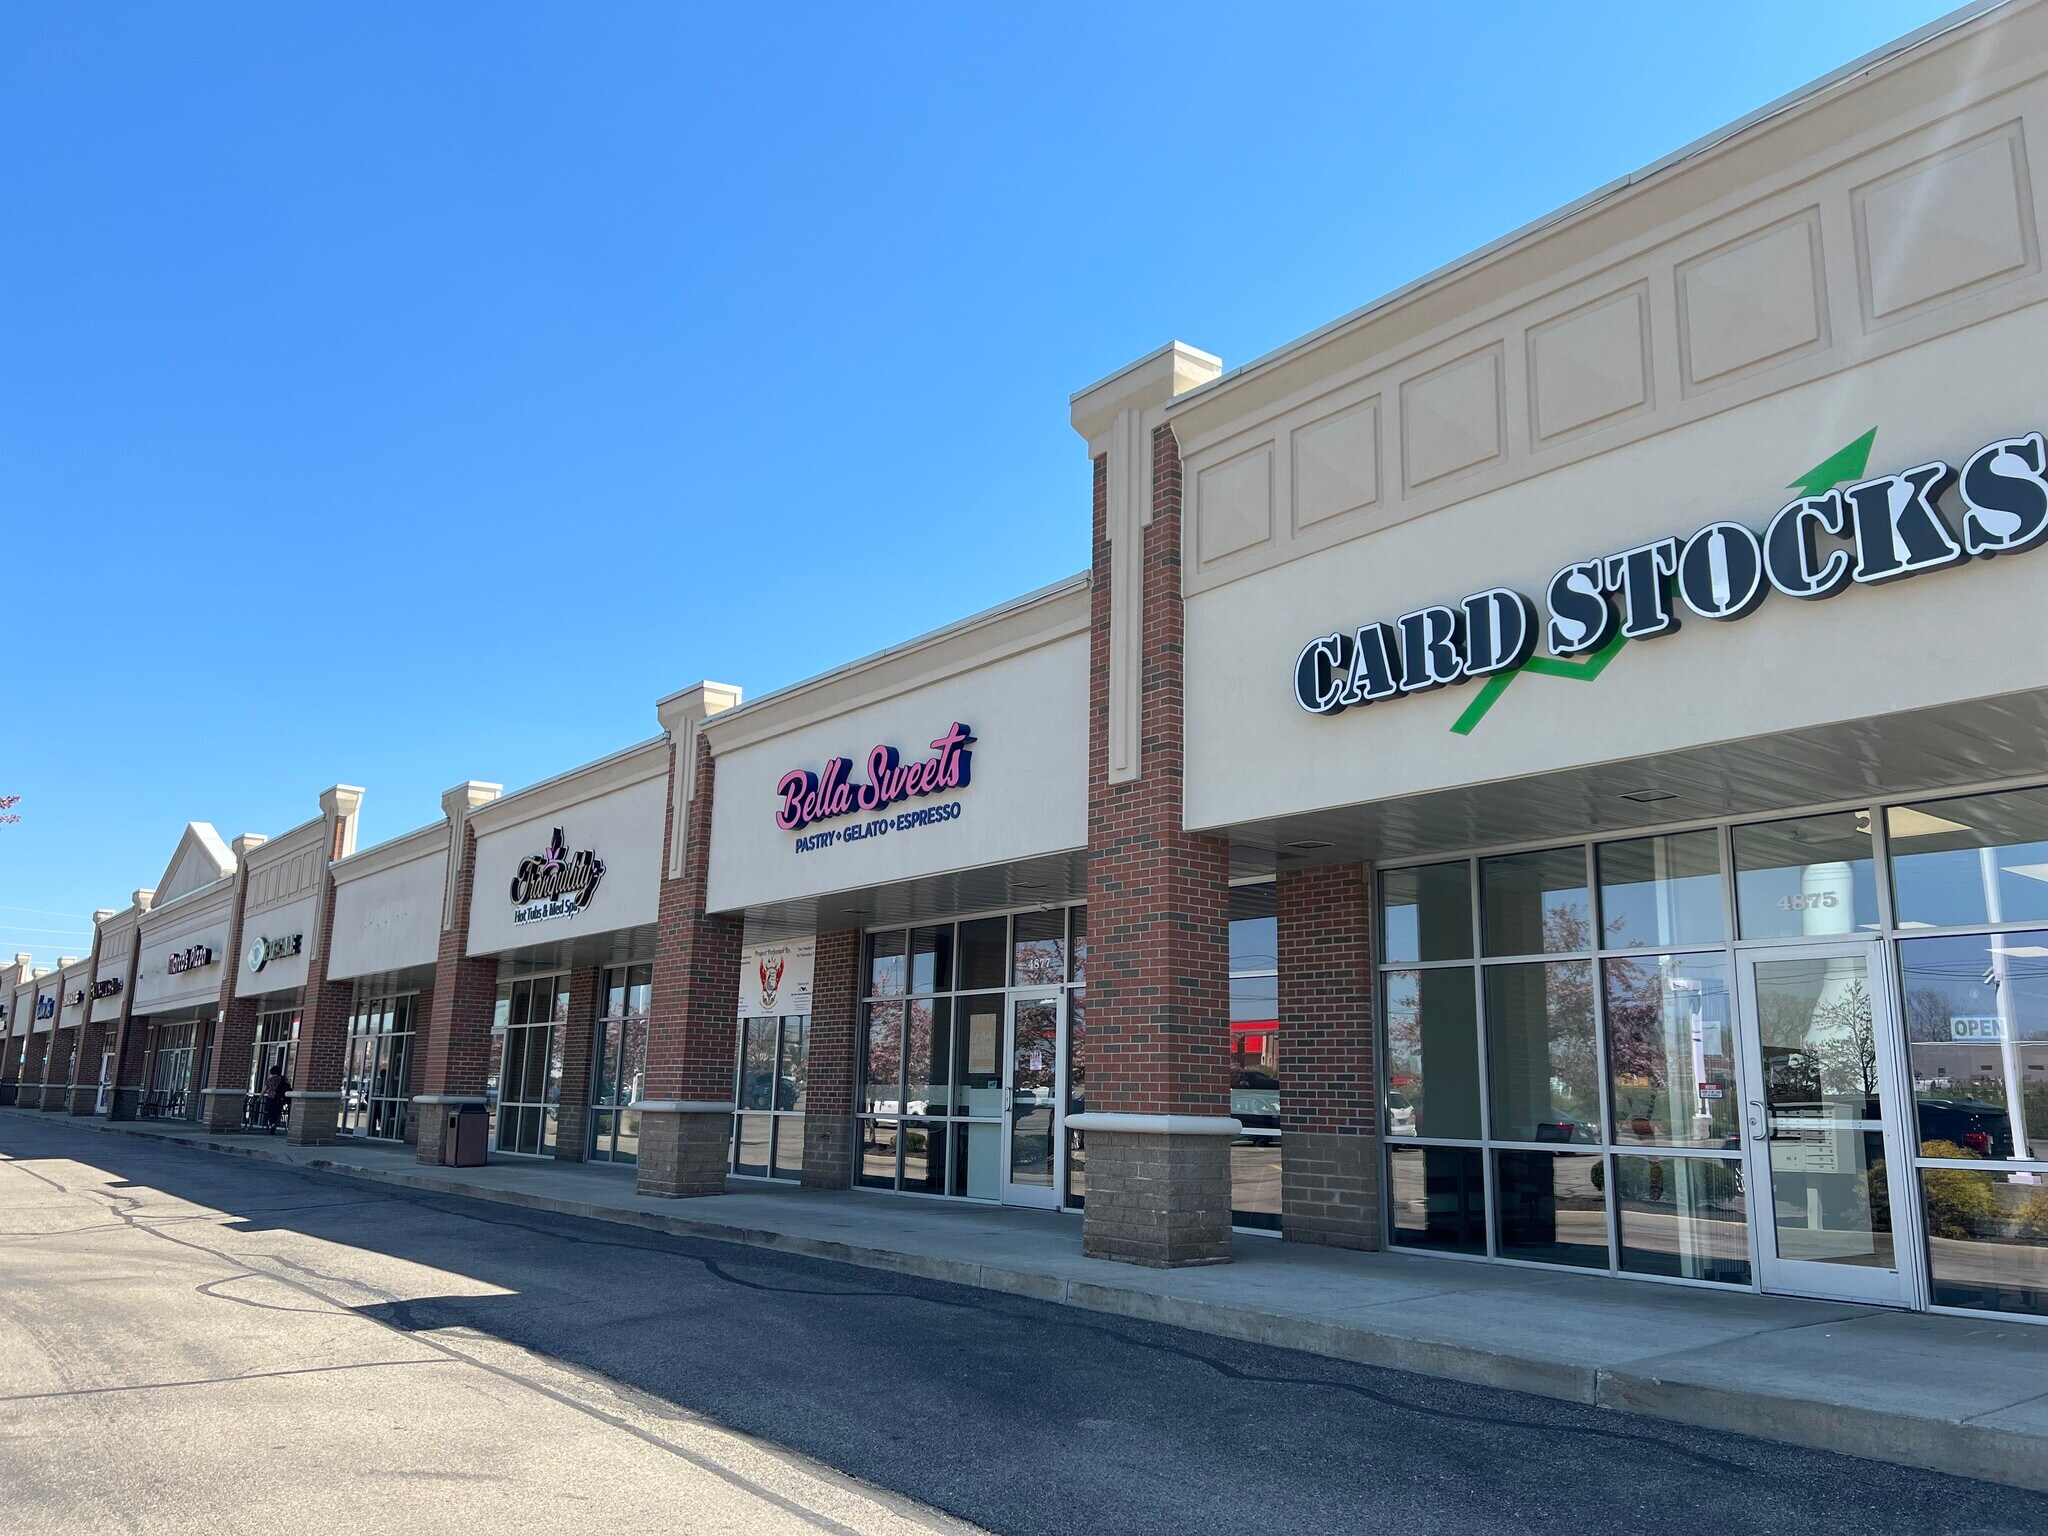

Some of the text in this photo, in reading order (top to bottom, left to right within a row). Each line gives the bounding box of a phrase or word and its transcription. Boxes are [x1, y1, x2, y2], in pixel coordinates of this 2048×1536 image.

[1294, 432, 2048, 714] CARD STOCKS
[776, 721, 971, 830] Bella Sweets
[795, 801, 961, 854] PASTRY GELATO ESPRESSO
[510, 848, 606, 908] Tranquility
[514, 909, 527, 924] Hot
[526, 905, 542, 921] Tubs
[542, 904, 549, 918] &
[549, 899, 564, 917] Med
[1777, 890, 1839, 911] 4875
[1028, 957, 1051, 969] 4877
[1954, 1019, 2004, 1037] OPEN
